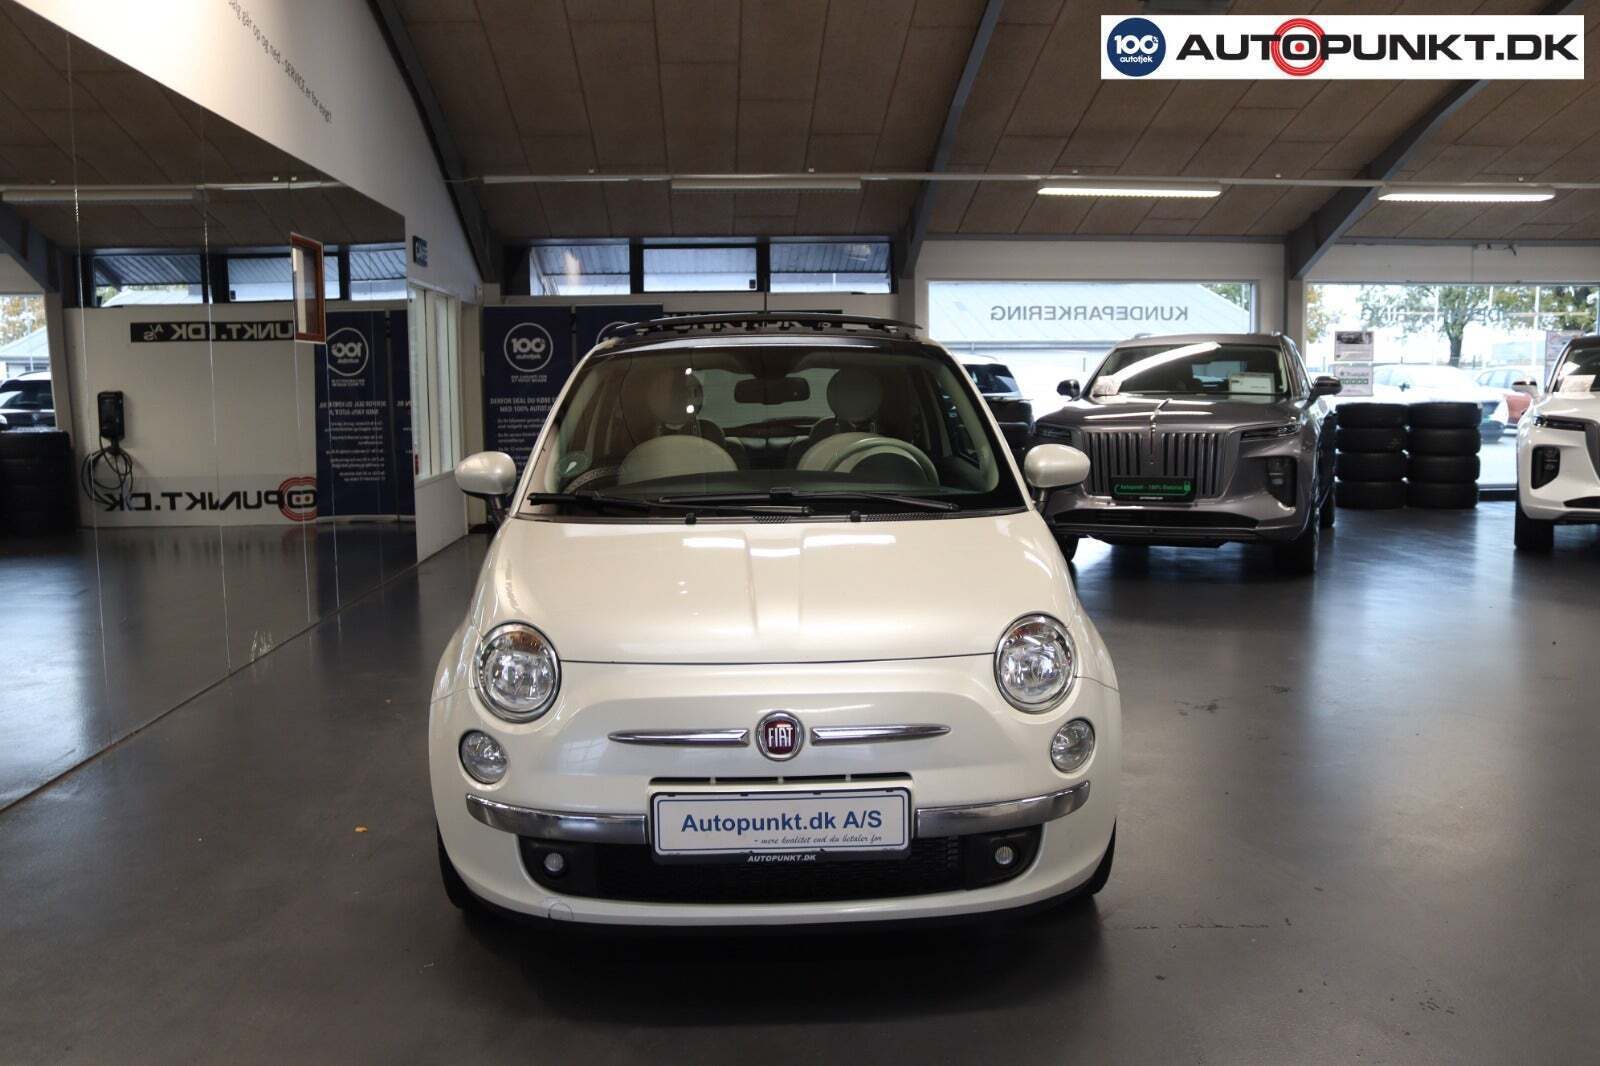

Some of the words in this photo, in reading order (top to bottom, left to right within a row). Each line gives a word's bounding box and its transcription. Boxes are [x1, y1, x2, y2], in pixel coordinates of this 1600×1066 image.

[768, 726, 793, 747] FIAT
[681, 811, 837, 836] Autopunkt.dk
[842, 810, 883, 829] A/S
[781, 835, 811, 844] kvalitet
[813, 836, 826, 844] end
[829, 835, 840, 843] du
[842, 834, 868, 843] betaler
[870, 834, 882, 844] for
[747, 854, 817, 863] AUTOPUNKT.DK
